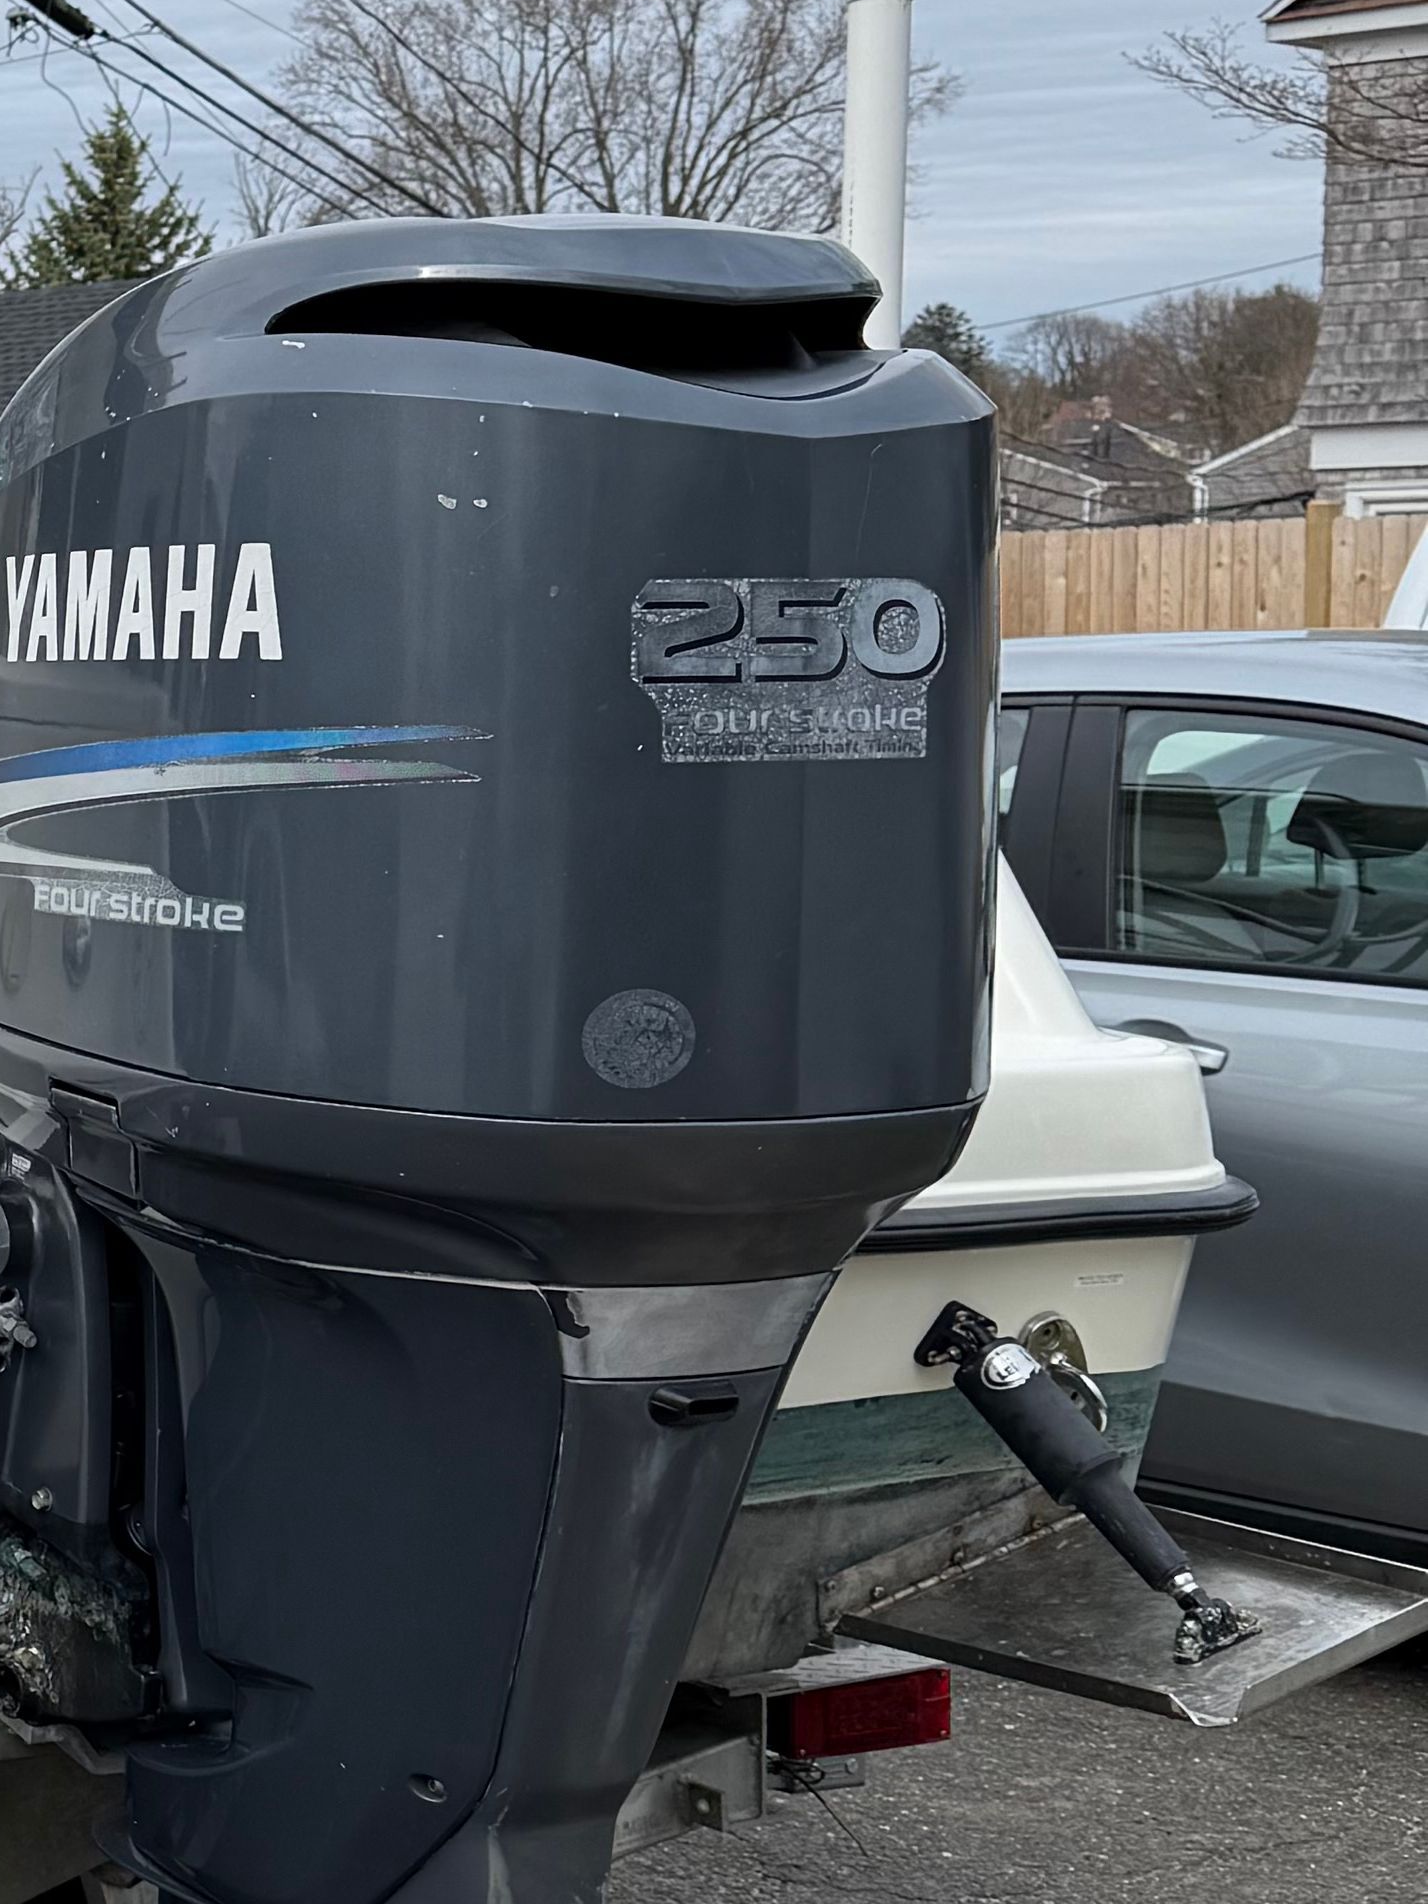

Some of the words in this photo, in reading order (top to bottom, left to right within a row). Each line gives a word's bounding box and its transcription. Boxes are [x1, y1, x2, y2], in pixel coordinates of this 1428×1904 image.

[6, 542, 283, 662] YAMAHA
[636, 578, 945, 684] 250
[108, 891, 245, 933] stroke
